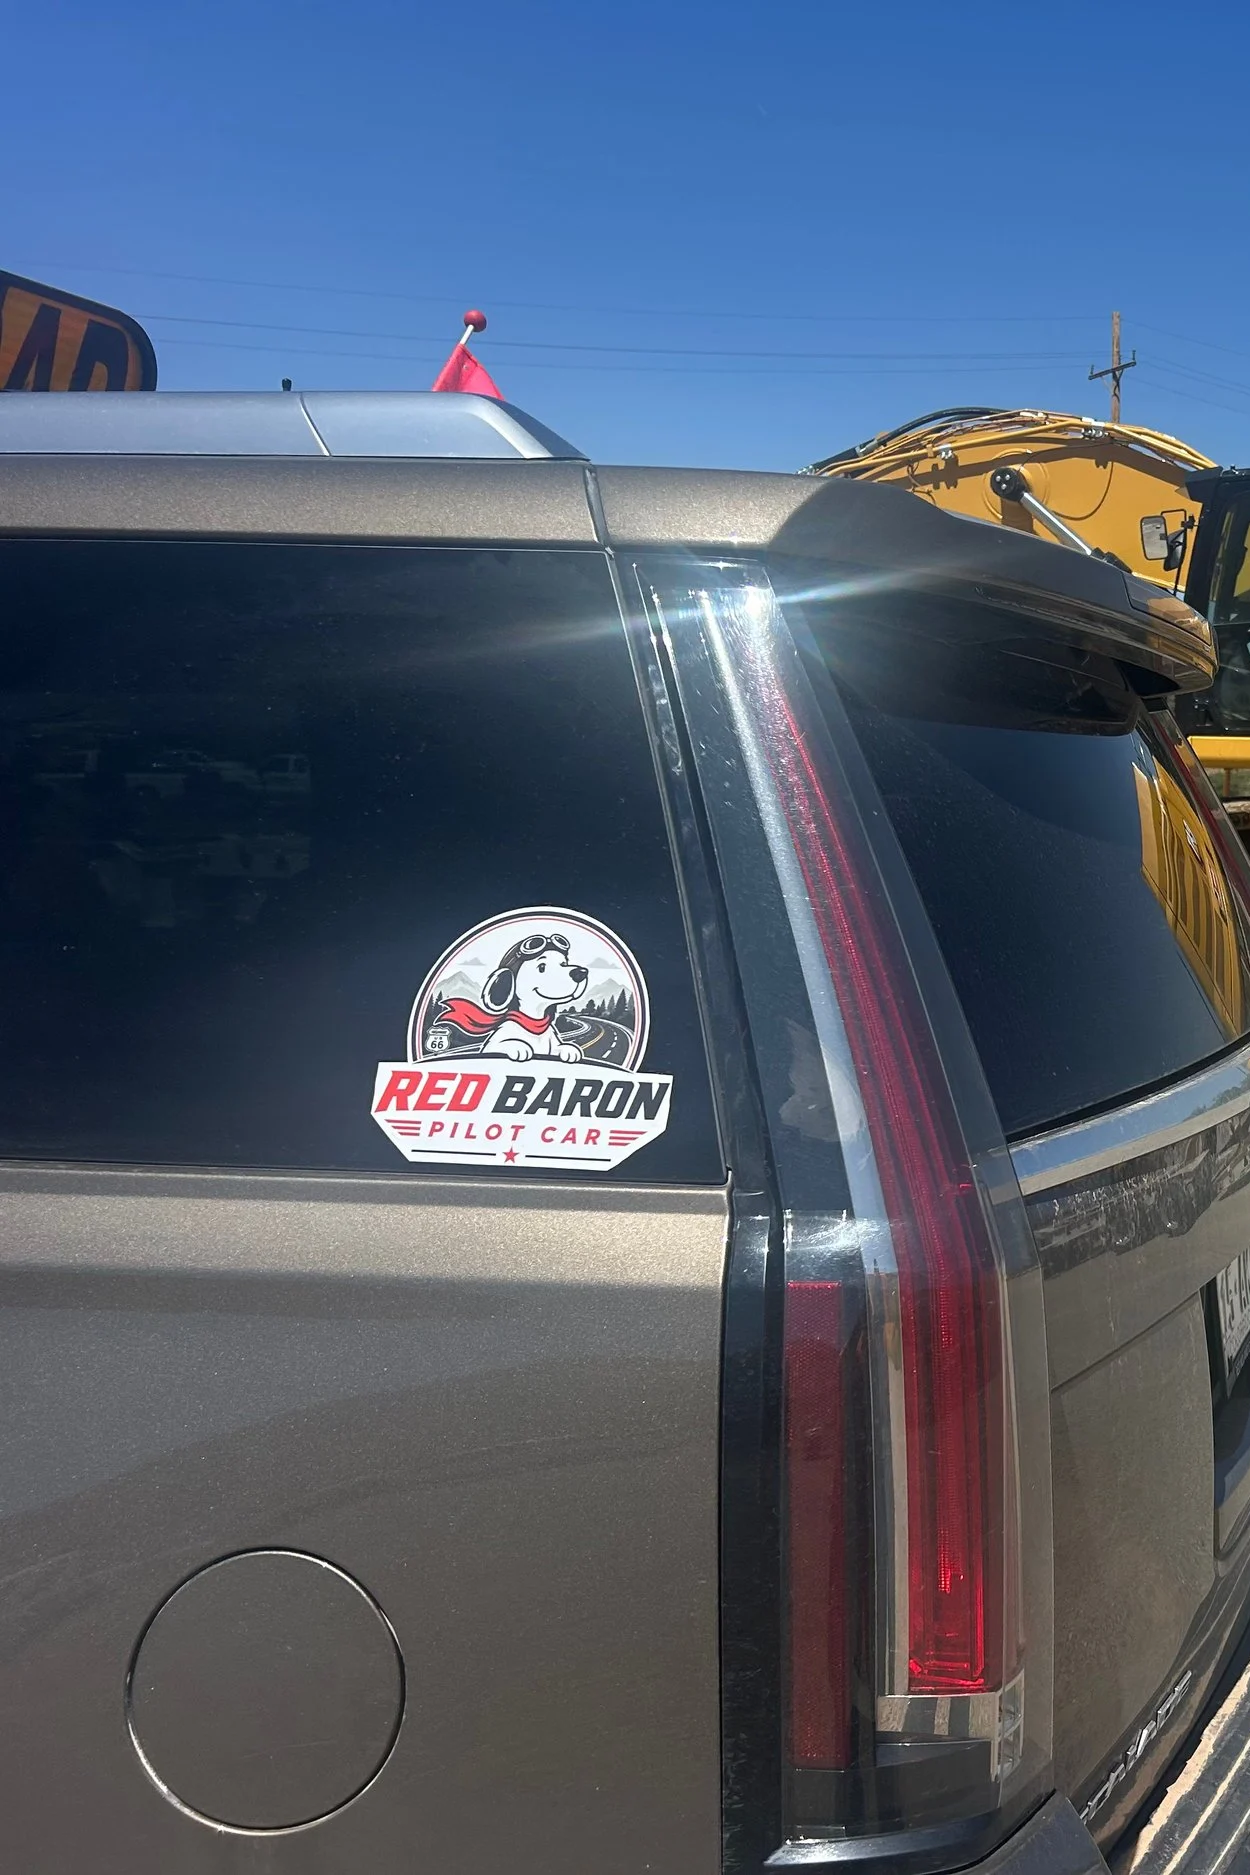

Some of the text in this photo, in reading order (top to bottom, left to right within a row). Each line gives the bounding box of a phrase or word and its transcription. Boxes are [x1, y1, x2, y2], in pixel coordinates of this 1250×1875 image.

[431, 1041, 444, 1049] 66
[375, 1070, 671, 1120] RED BARON
[428, 1121, 601, 1145] PILOT CAR
